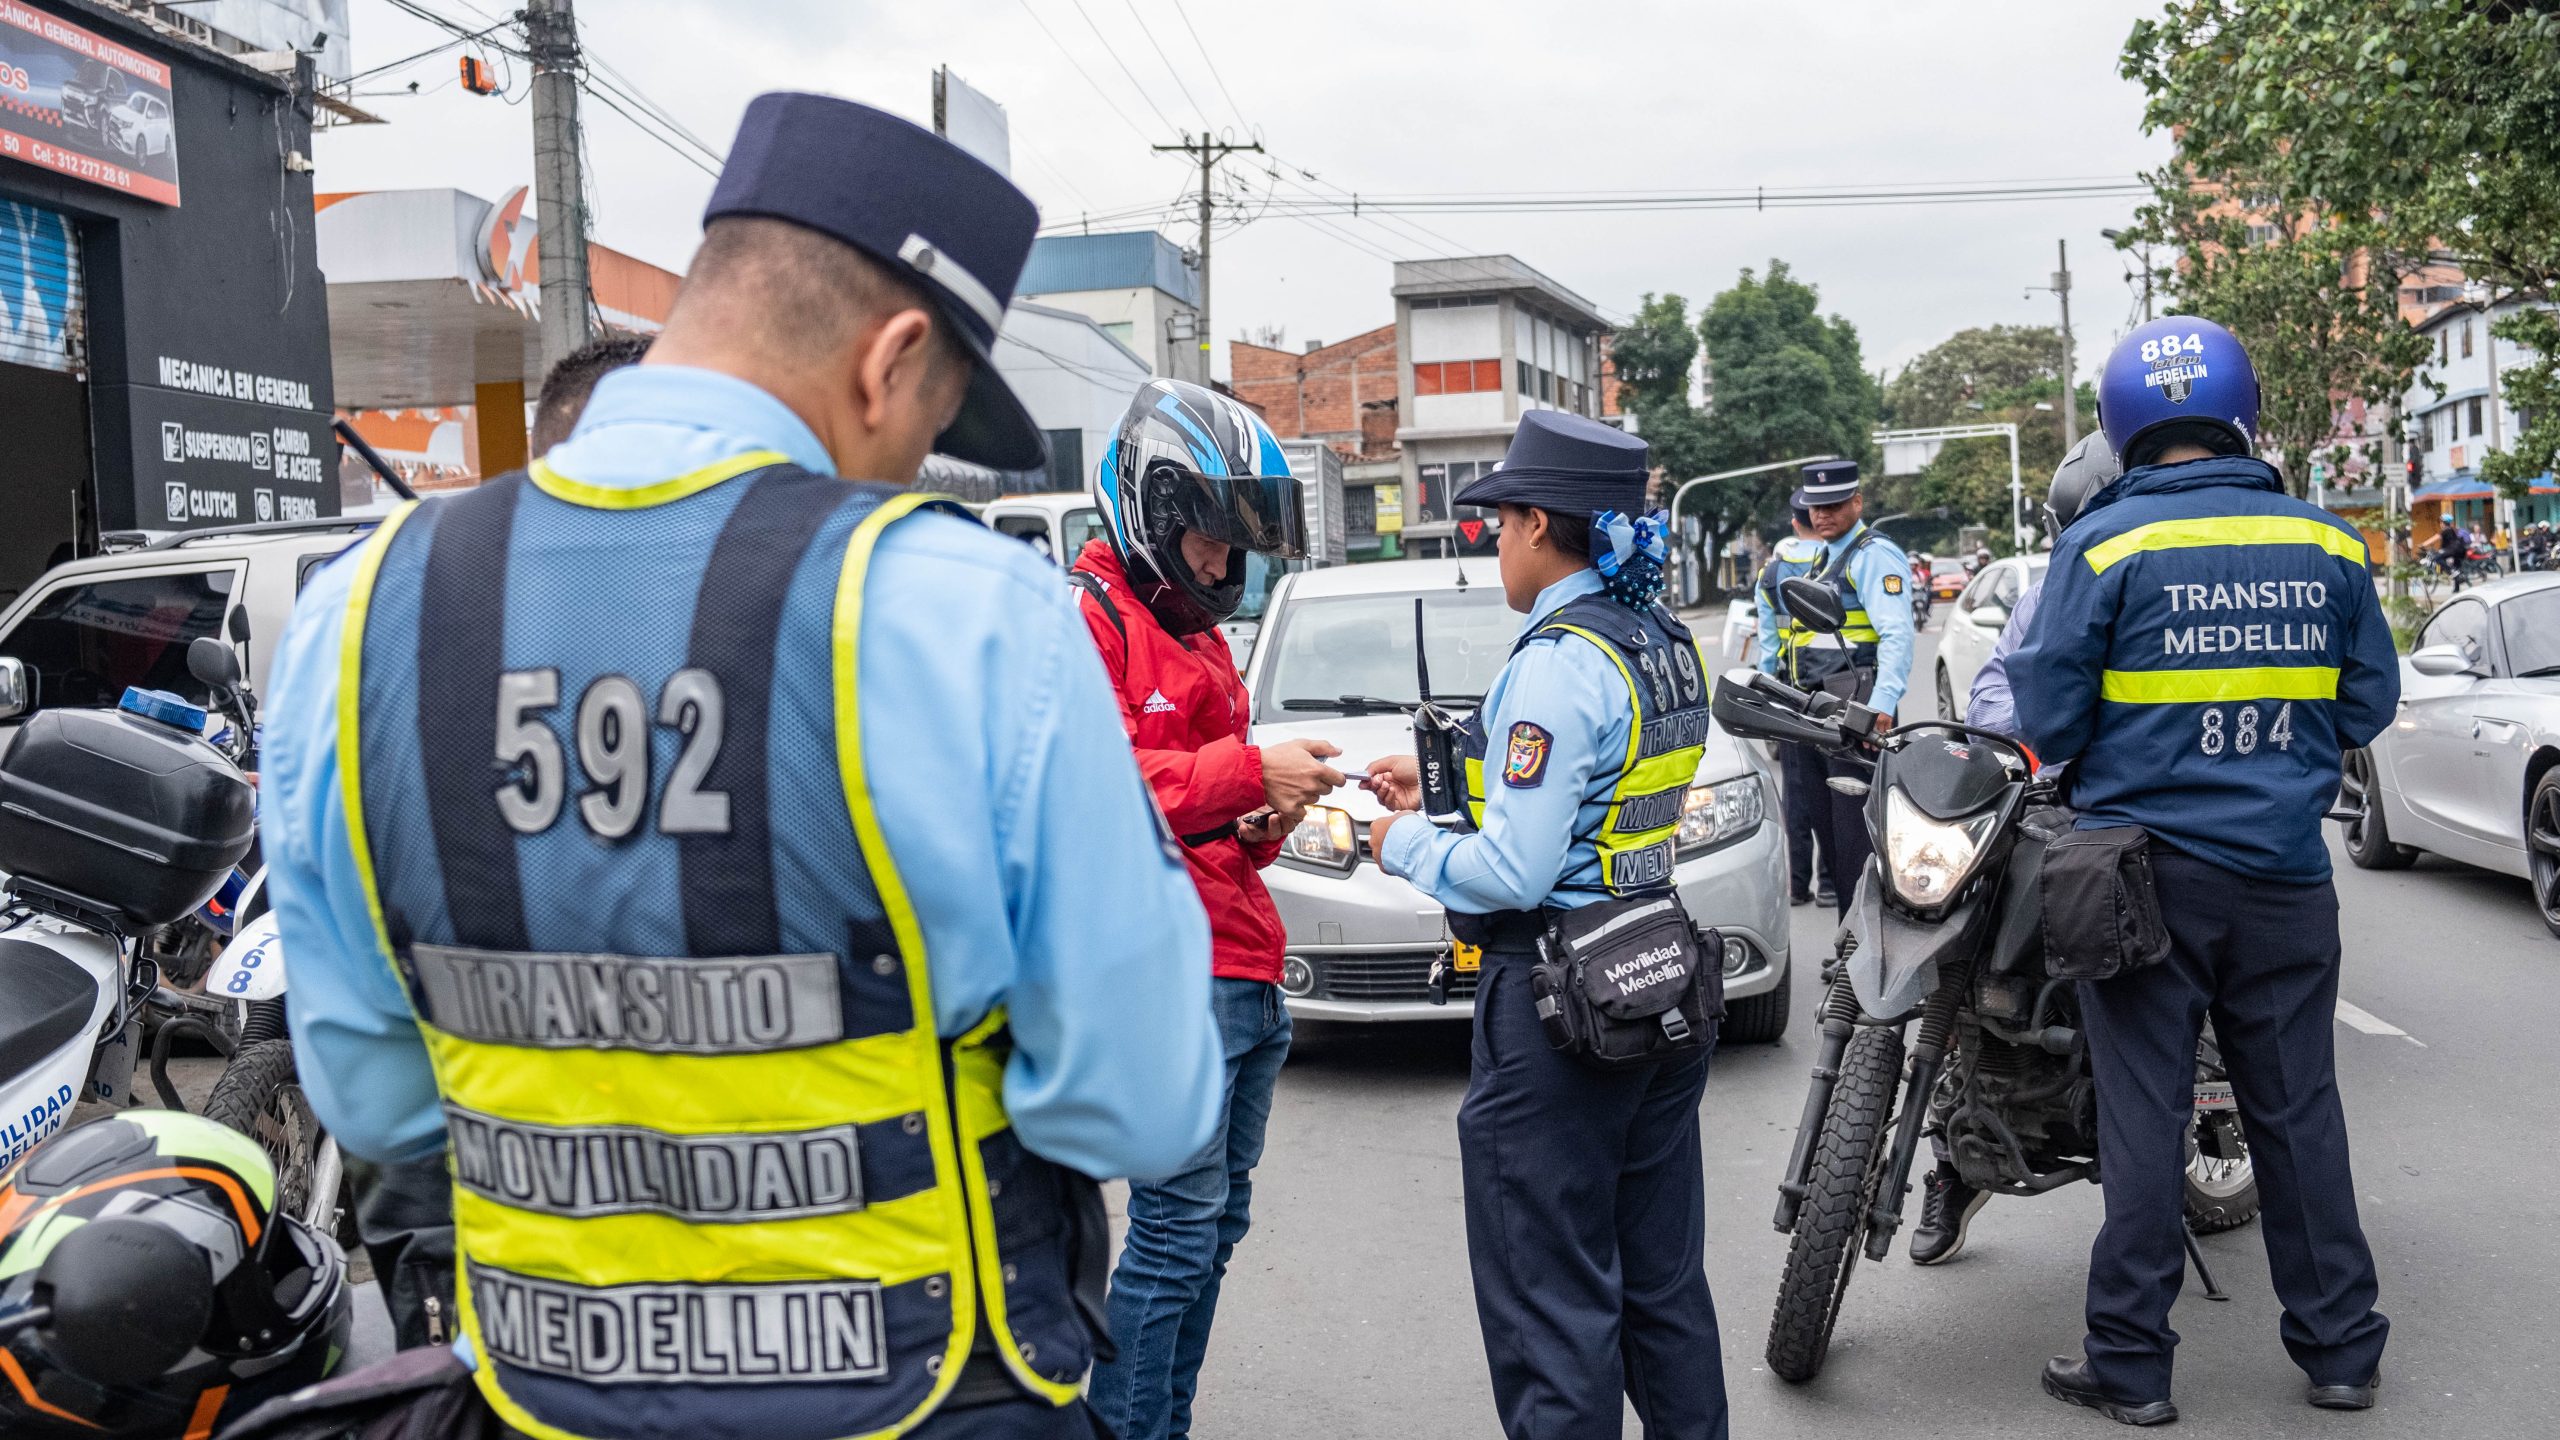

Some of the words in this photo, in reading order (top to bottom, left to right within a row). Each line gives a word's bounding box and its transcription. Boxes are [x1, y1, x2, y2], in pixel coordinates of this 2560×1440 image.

[44, 21, 95, 56] GENERAL
[97, 43, 161, 84] AUTOMOTRIZ
[4, 134, 20, 154] 50
[32, 143, 54, 165] Cel:
[57, 151, 79, 172] 312
[80, 159, 100, 179] 277
[102, 165, 117, 183] 28
[118, 170, 131, 187] 61
[2140, 333, 2205, 363] 884
[159, 356, 234, 398] MECANICA
[234, 371, 254, 401] EN
[255, 375, 314, 411] GENERAL
[2144, 364, 2208, 388] MEDELLIN
[184, 430, 251, 463] SUSPENSION
[272, 427, 310, 457] CAMBIO
[274, 453, 289, 479] DE
[290, 456, 323, 483] ACEITE
[189, 489, 238, 519] CLUTCH
[279, 495, 317, 521] FRENOS
[2163, 581, 2327, 612] TRANSITO
[2164, 624, 2328, 655] MEDELLIN
[1640, 642, 1699, 713] 319
[1143, 703, 1176, 714] adidas
[2200, 701, 2294, 756] 884
[495, 667, 731, 837] 592
[1604, 942, 1682, 984] Movilidad
[1618, 960, 1686, 996] Medellín
[444, 957, 792, 1048] TRANSITO
[452, 1111, 856, 1213] MOVILIDAD
[476, 1276, 882, 1376] MEDELLIN
